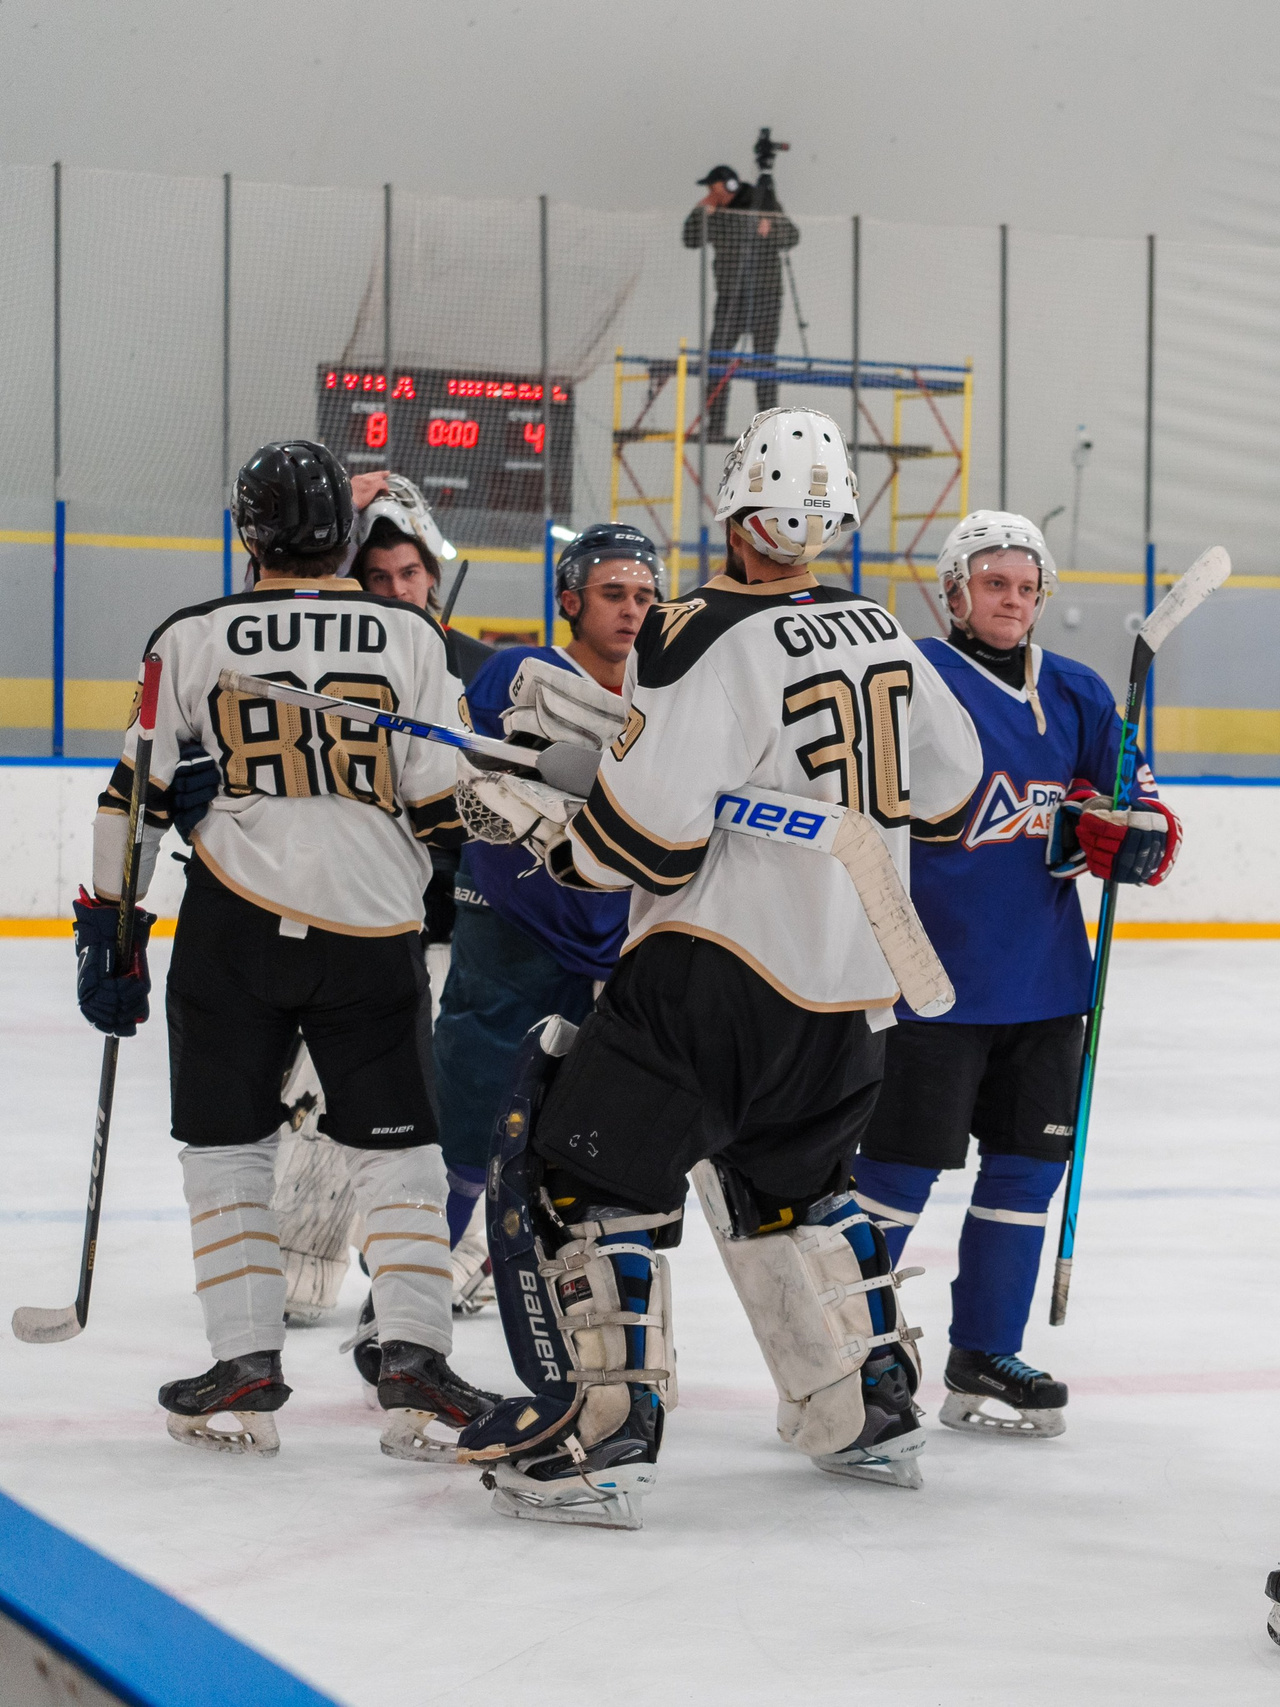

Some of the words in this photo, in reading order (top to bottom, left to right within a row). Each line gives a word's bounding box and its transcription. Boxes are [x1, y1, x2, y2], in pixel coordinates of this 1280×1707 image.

[366, 411, 388, 448] 8
[428, 418, 479, 448] 0:00
[524, 422, 546, 454] 4
[240, 493, 254, 506] CCM
[615, 532, 645, 543] CCM
[226, 612, 388, 656] GUTID
[774, 607, 899, 658] GUTID
[512, 671, 525, 698] CCM
[207, 670, 403, 818] 88
[781, 659, 914, 829] 30
[1118, 722, 1139, 811] NEX
[714, 794, 828, 841] BAU
[371, 1124, 415, 1135] BAUER
[518, 1269, 561, 1382] BAUER
